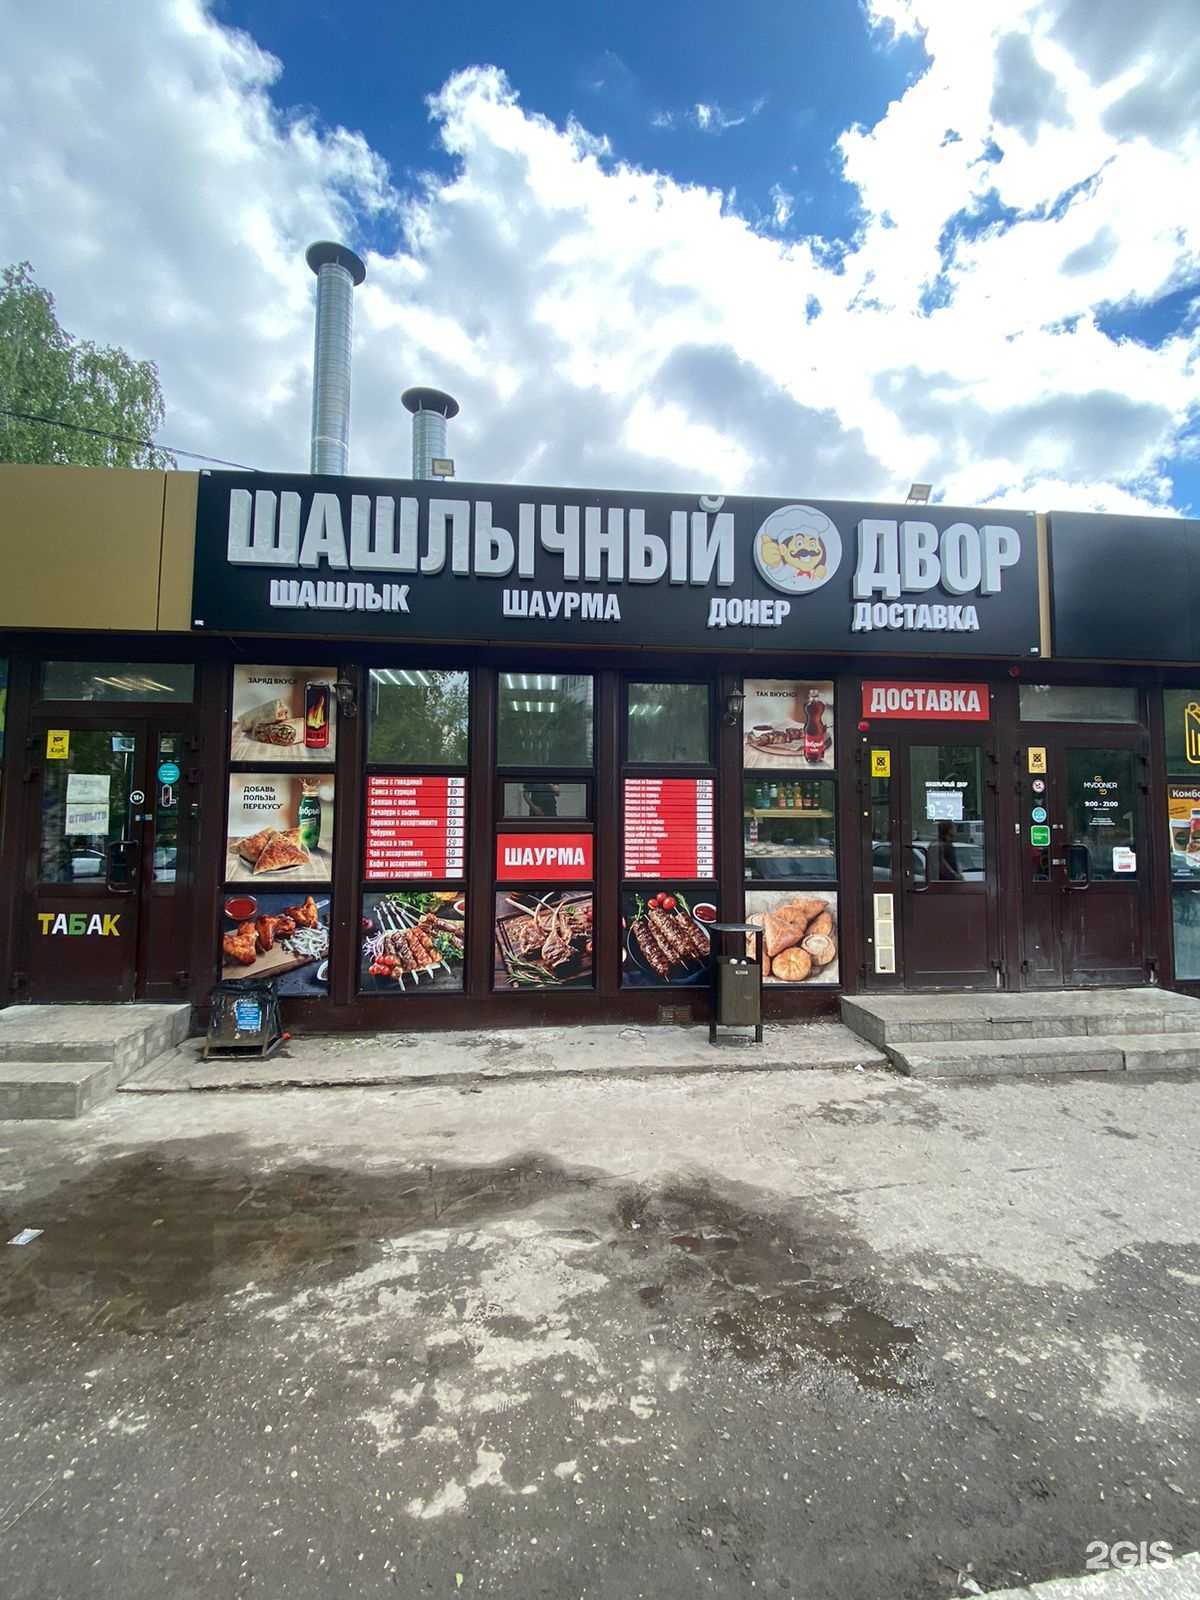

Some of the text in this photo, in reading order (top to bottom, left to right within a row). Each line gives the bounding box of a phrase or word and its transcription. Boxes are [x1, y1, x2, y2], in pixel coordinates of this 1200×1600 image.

[227, 488, 1021, 600] ШАШЛЫЧНЫЙ ДВОР
[269, 579, 410, 614] ШАШЛЫК
[502, 589, 621, 621] ШАУРМА
[706, 597, 791, 629] ДОНЕР
[852, 601, 980, 632] ДОСТАВКА
[247, 677, 272, 685] ЗАРЯД
[870, 687, 981, 713] ДОСТАВКА
[243, 785, 276, 793] ДОБАВЬ
[503, 846, 585, 867] ШАУРМА
[38, 912, 121, 937] ТАБАК
